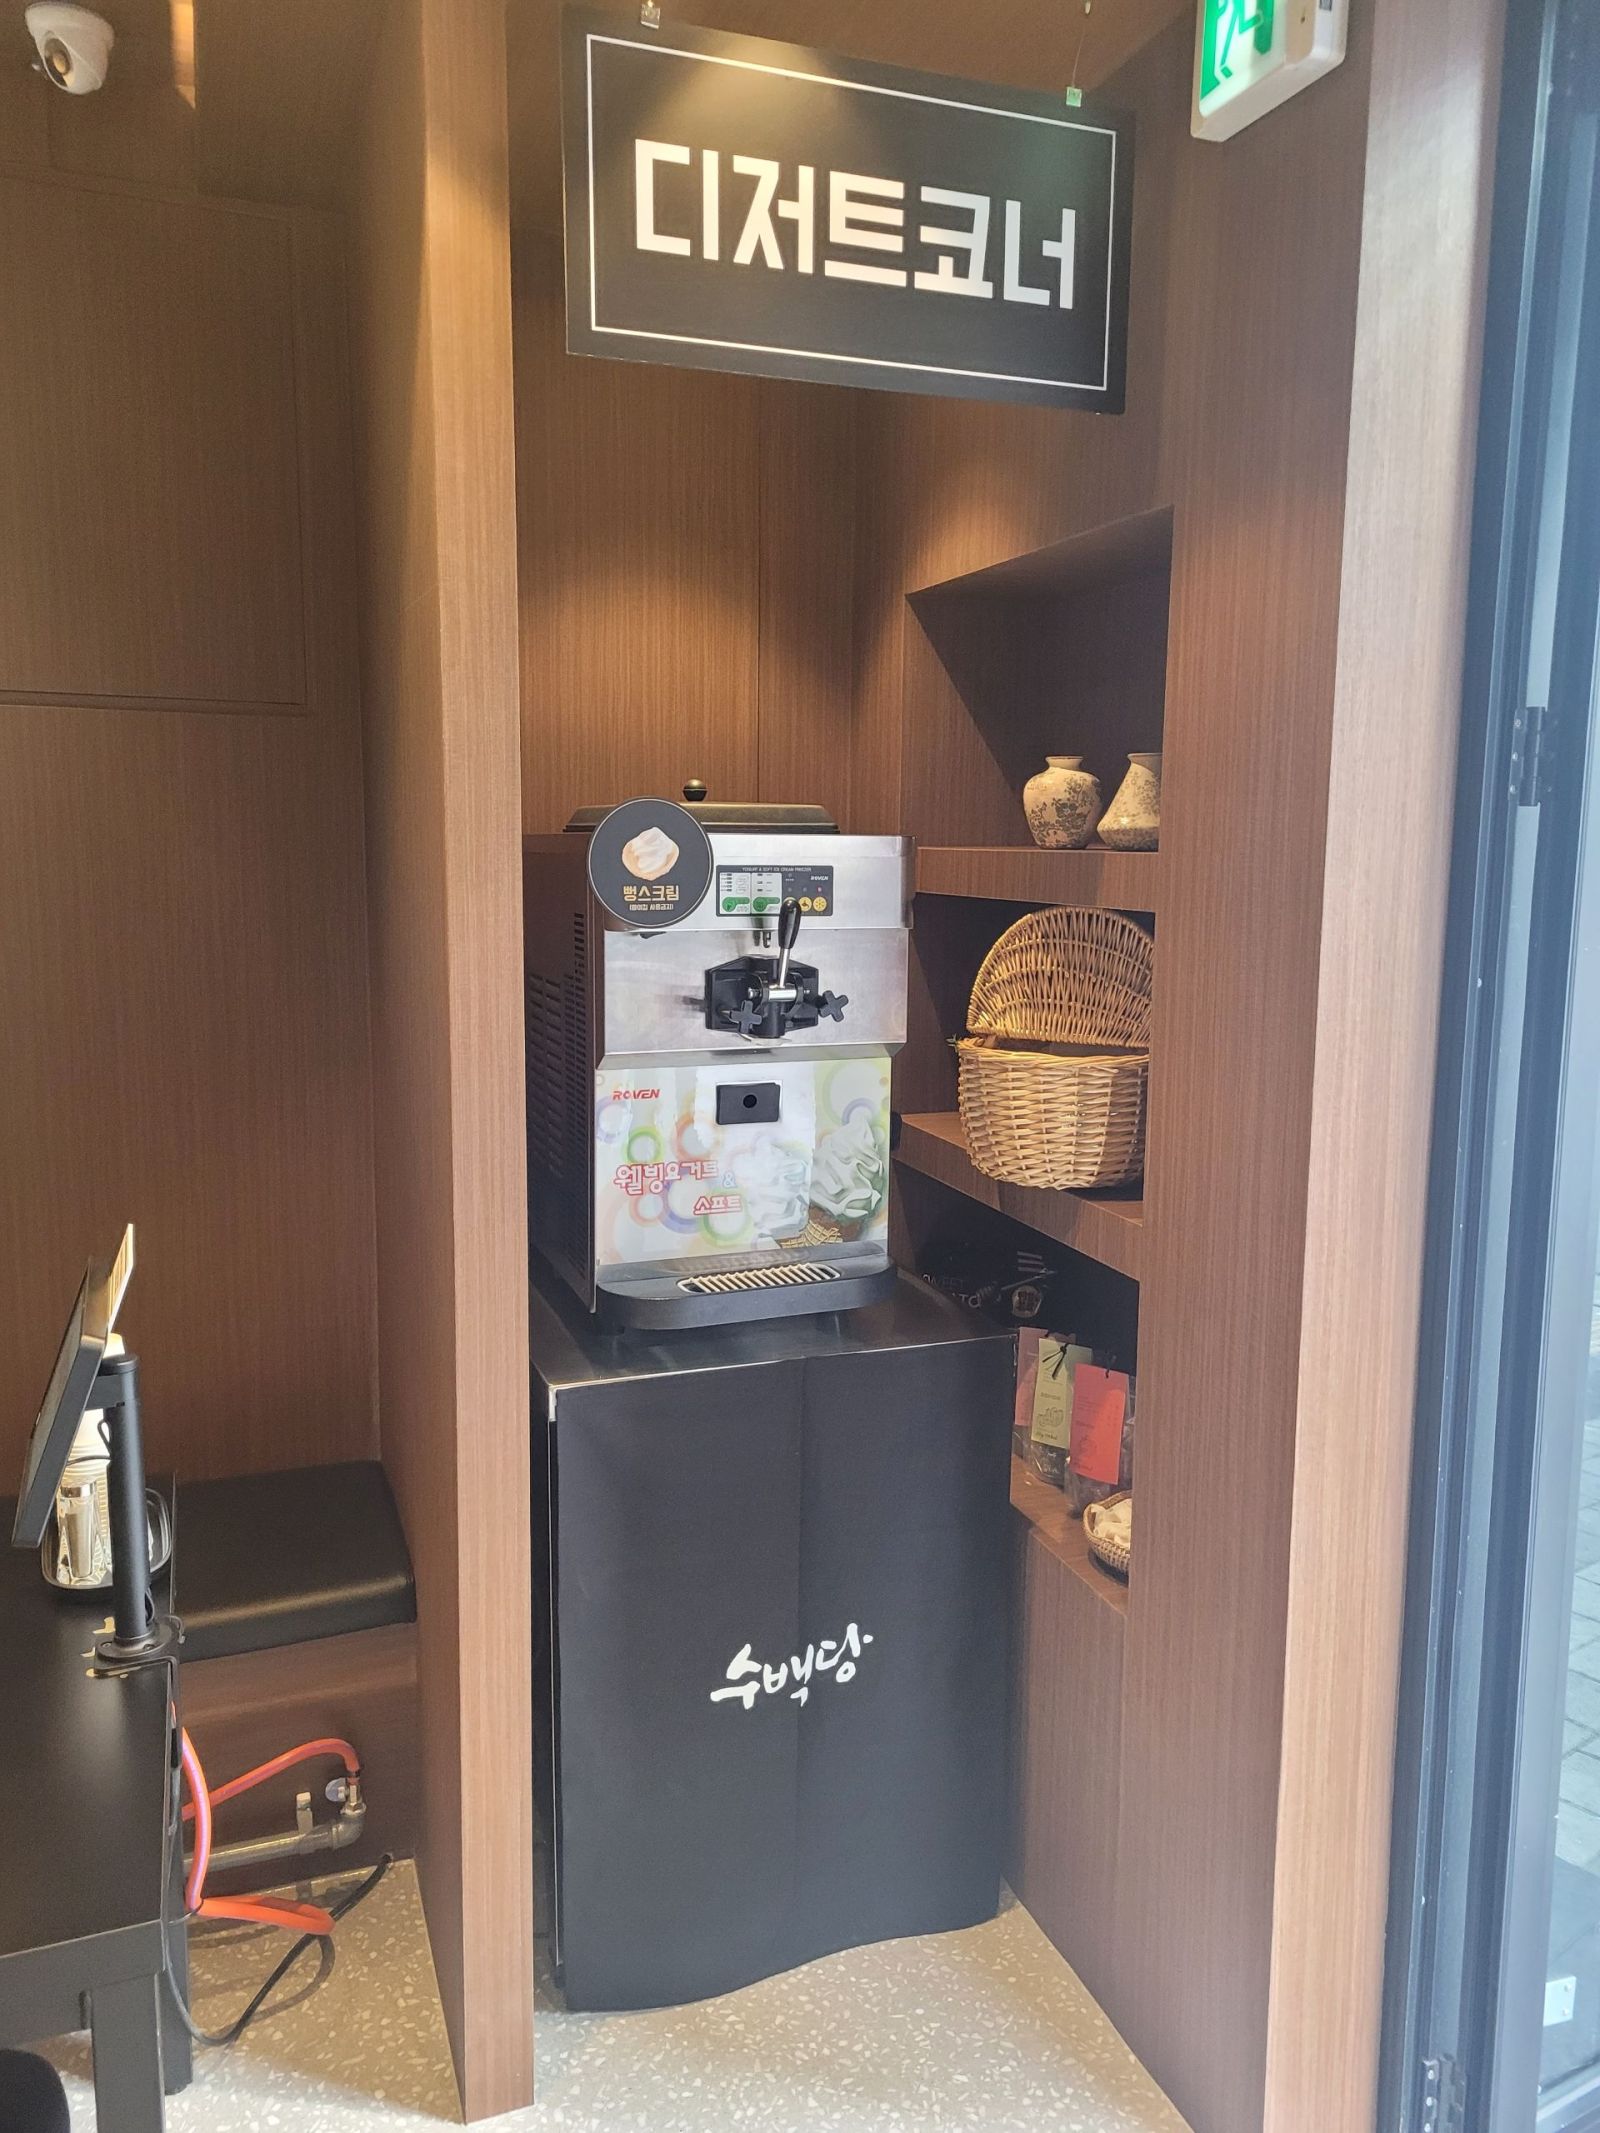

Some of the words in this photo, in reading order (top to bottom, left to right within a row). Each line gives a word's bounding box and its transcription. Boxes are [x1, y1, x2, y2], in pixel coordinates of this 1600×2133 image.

[634, 138, 1076, 310] 디저트코너
[623, 885, 679, 901] 뻥스크림
[612, 1088, 661, 1100] ROVEN
[613, 1160, 719, 1196] 웰빙요거트
[693, 1195, 742, 1216] 소프트
